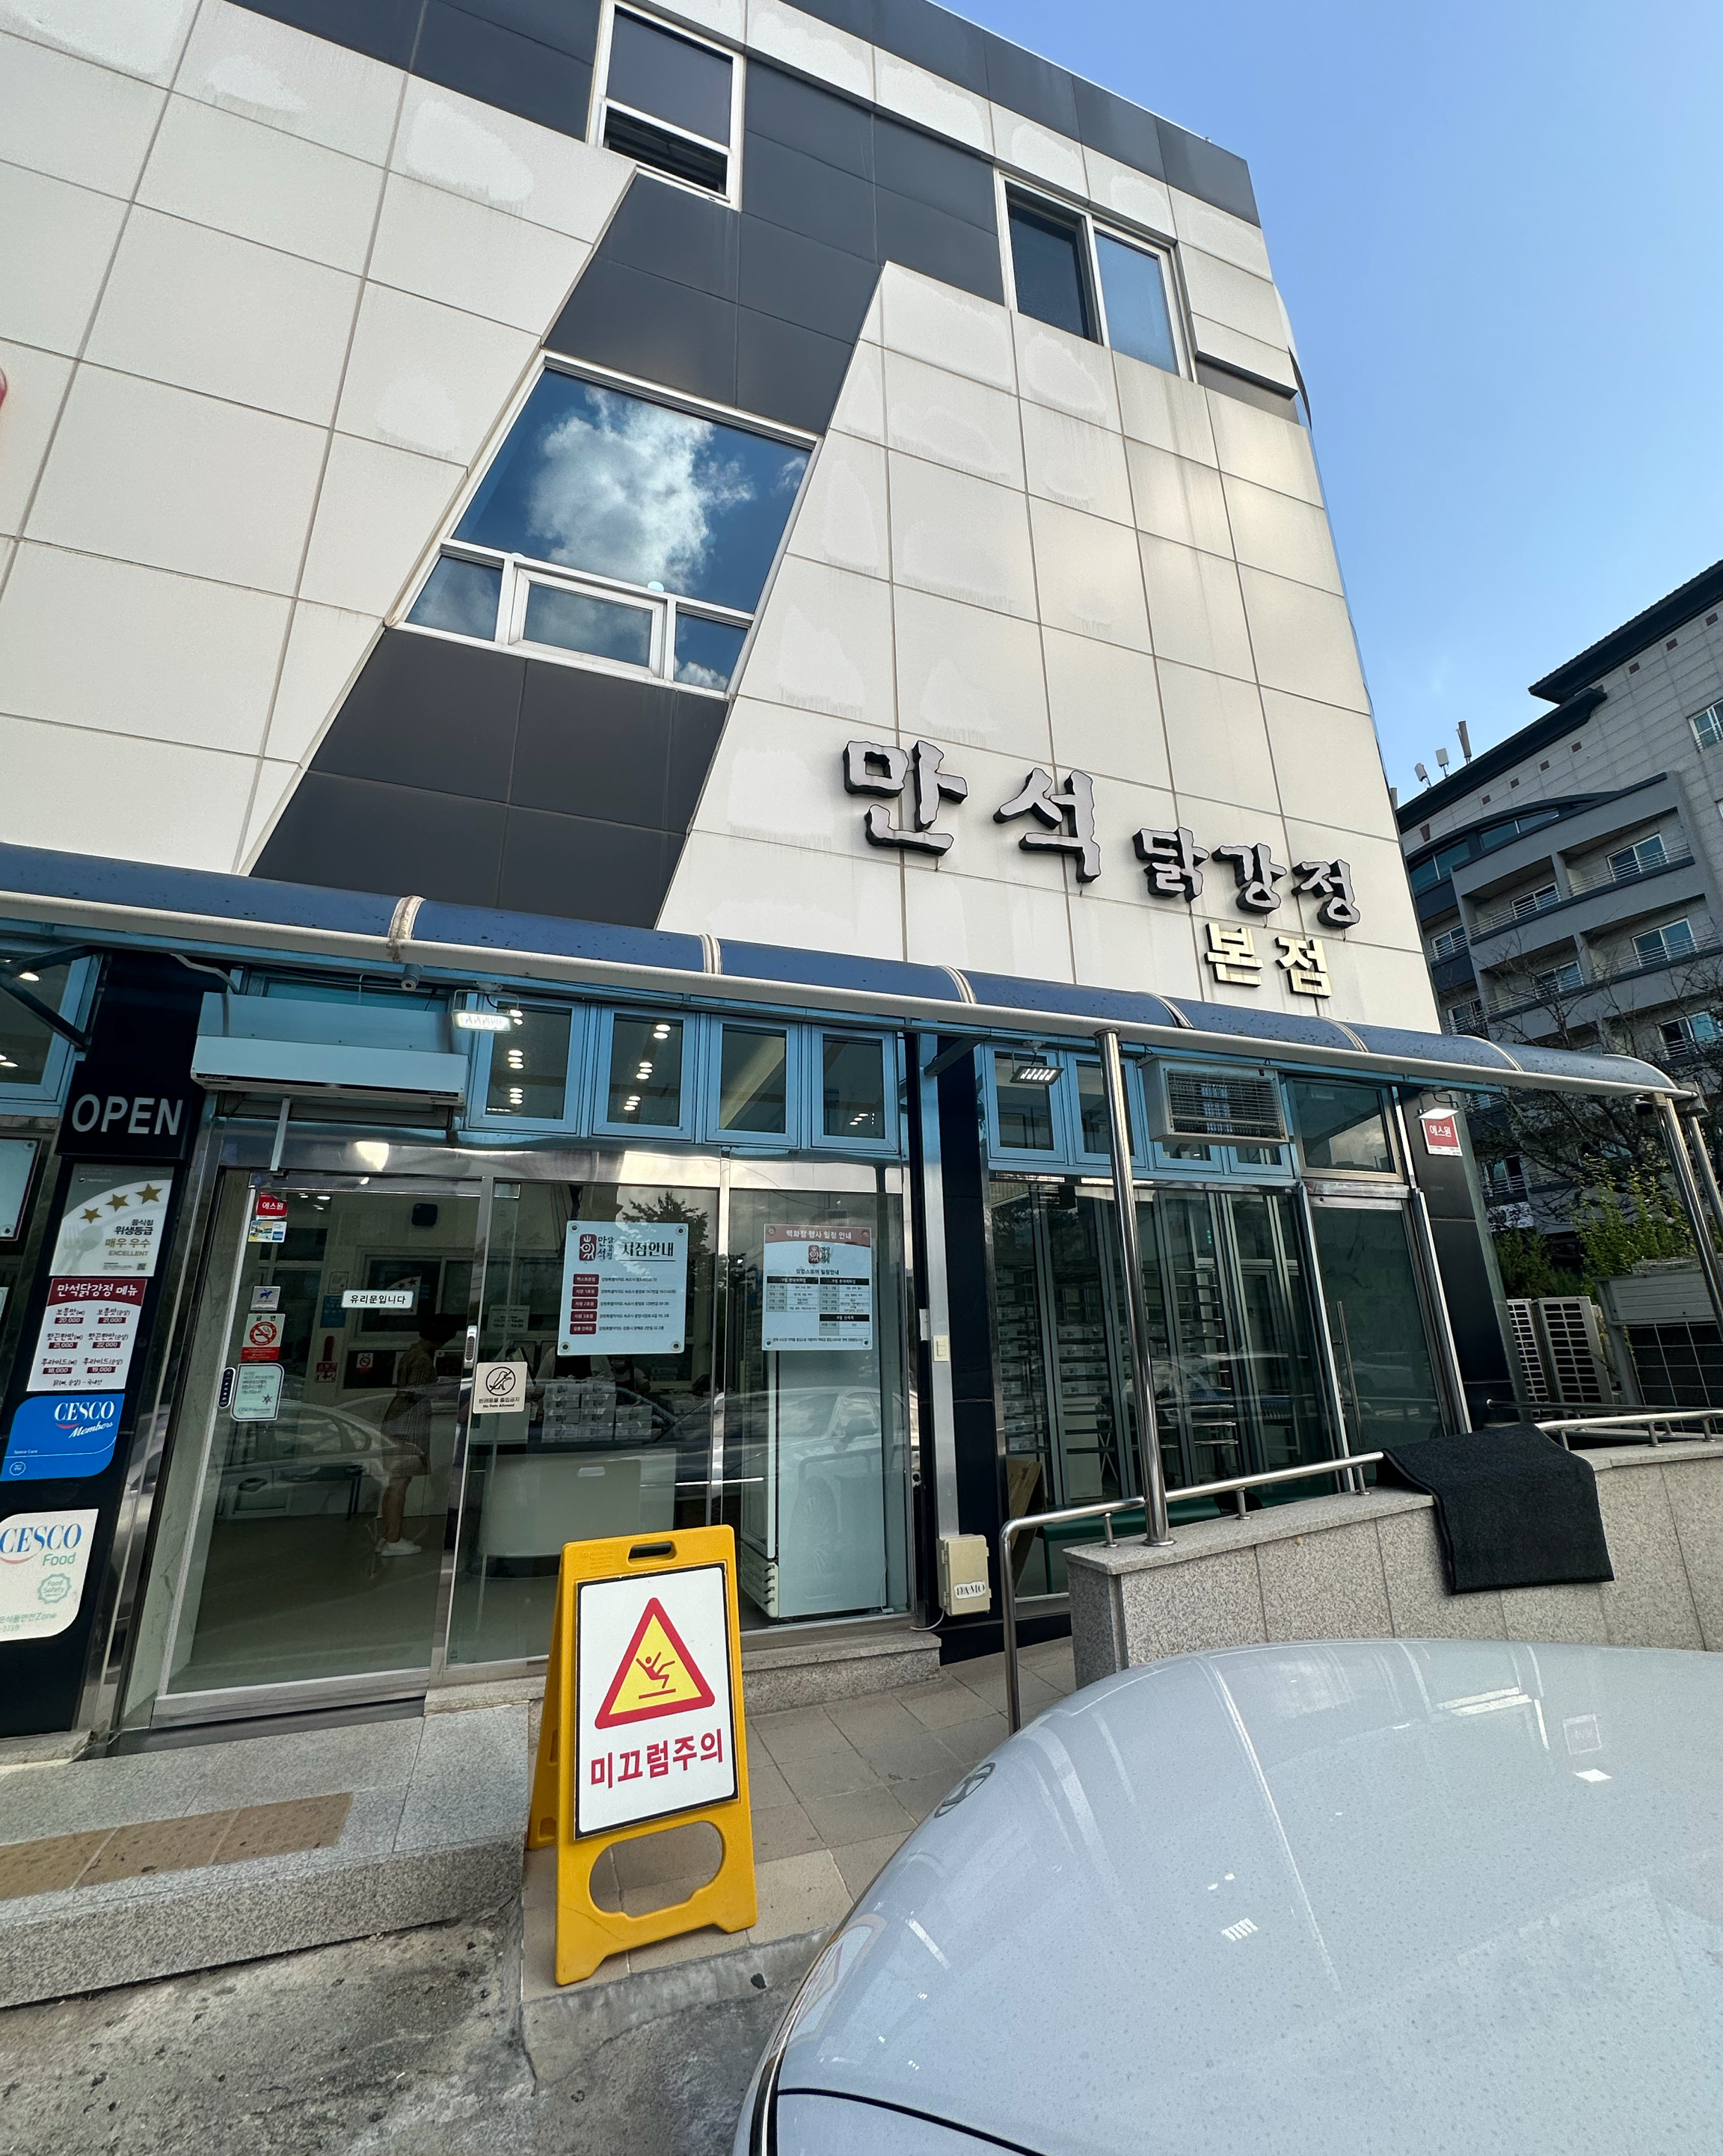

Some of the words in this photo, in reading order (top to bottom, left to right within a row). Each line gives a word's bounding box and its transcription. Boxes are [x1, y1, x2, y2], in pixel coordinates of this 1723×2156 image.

[844, 740, 1101, 883] 만석
[1133, 826, 1361, 929] 닭강정
[1206, 922, 1332, 998] 본점
[72, 1093, 183, 1136] OPEN
[1429, 1125, 1452, 1137] 에스원
[262, 1202, 284, 1210] 에스원
[114, 1226, 154, 1235] 위생등급
[823, 1231, 838, 1239] 일정
[838, 1232, 852, 1240] 안내
[105, 1238, 127, 1248] 매우
[129, 1238, 151, 1248] 우수
[622, 1241, 674, 1257] 지점안내
[57, 1283, 114, 1297] 만석닭강정
[116, 1285, 138, 1296] 메뉴
[350, 1294, 406, 1304] 유리문입니다
[54, 1401, 115, 1422] CESCO
[68, 1421, 114, 1439] Members
[0, 1523, 82, 1553] CESCO
[43, 1552, 77, 1566] Food
[956, 1584, 985, 1596] DAMO
[590, 1729, 724, 1790] 미끄럼주의
